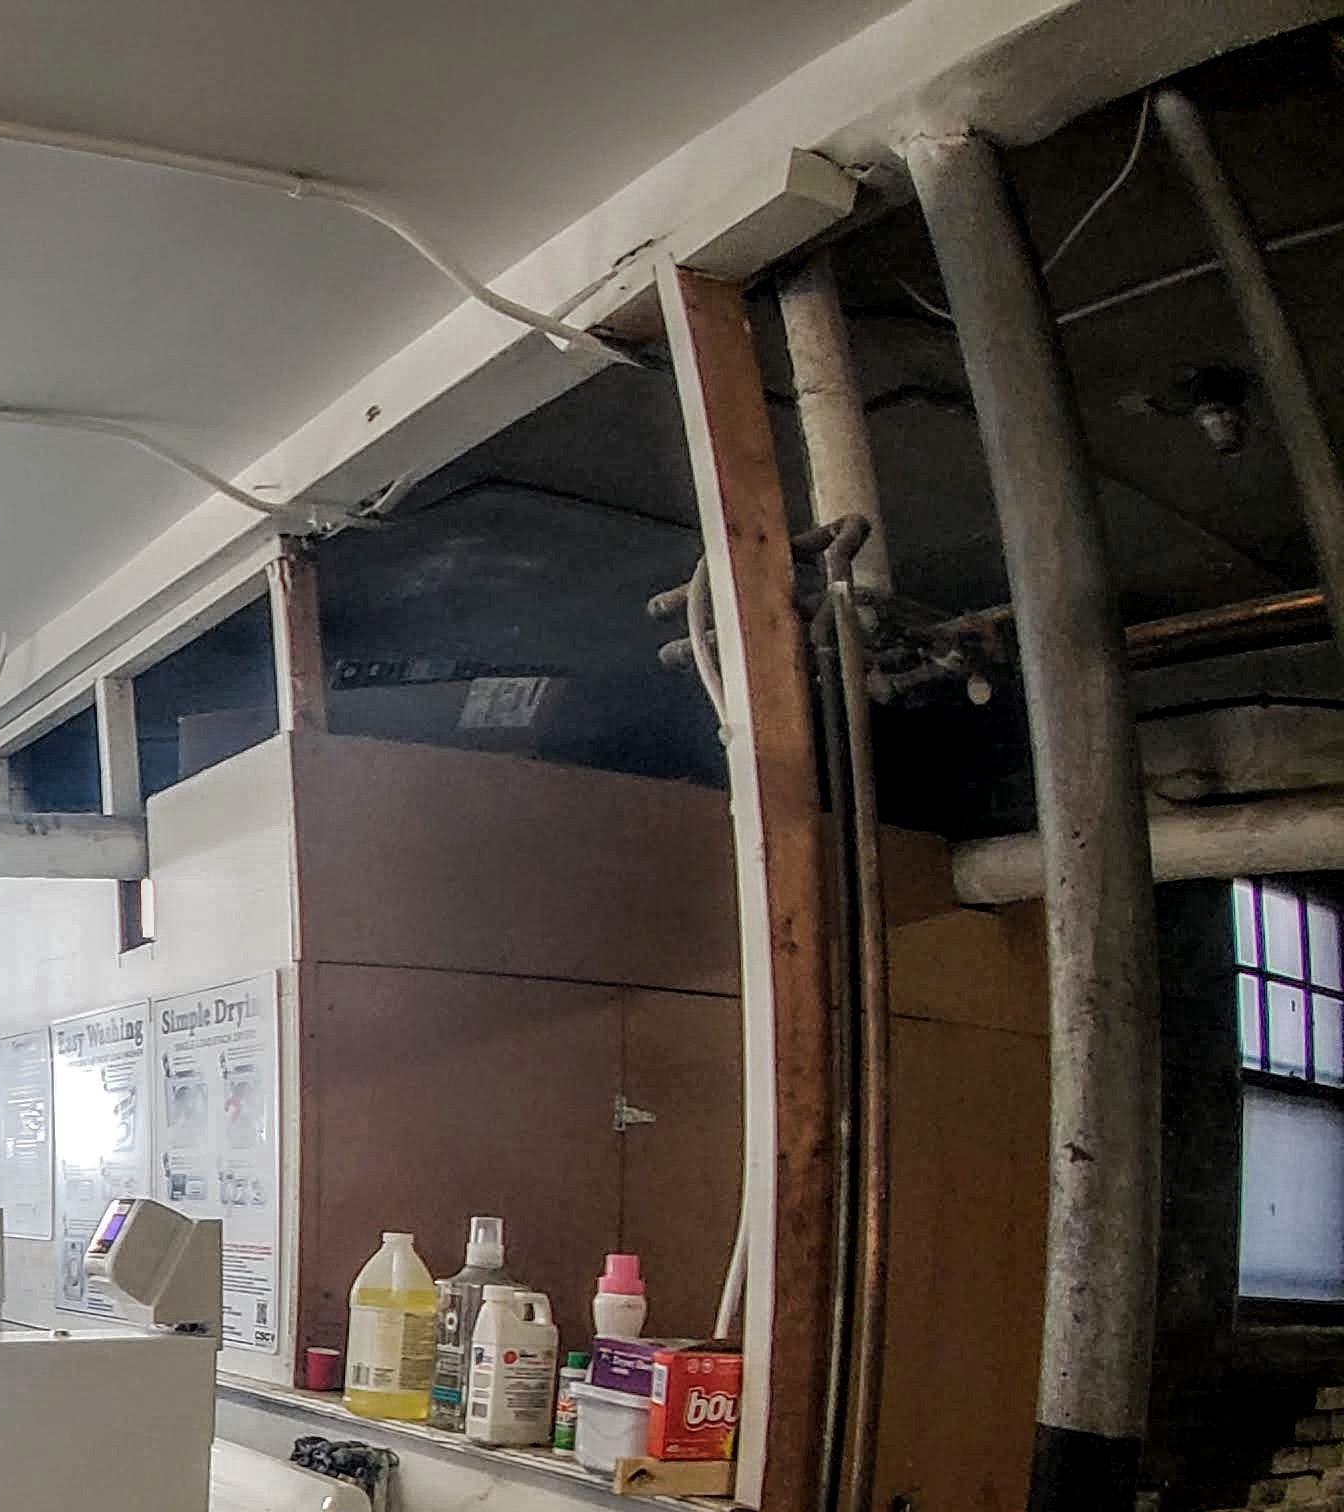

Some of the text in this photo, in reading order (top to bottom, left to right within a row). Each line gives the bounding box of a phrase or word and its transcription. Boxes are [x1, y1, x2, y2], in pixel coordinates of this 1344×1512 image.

[162, 1002, 210, 1037] Simple
[57, 1031, 84, 1056] Easy
[86, 1019, 144, 1046] Washing
[687, 1391, 737, 1425] bou
